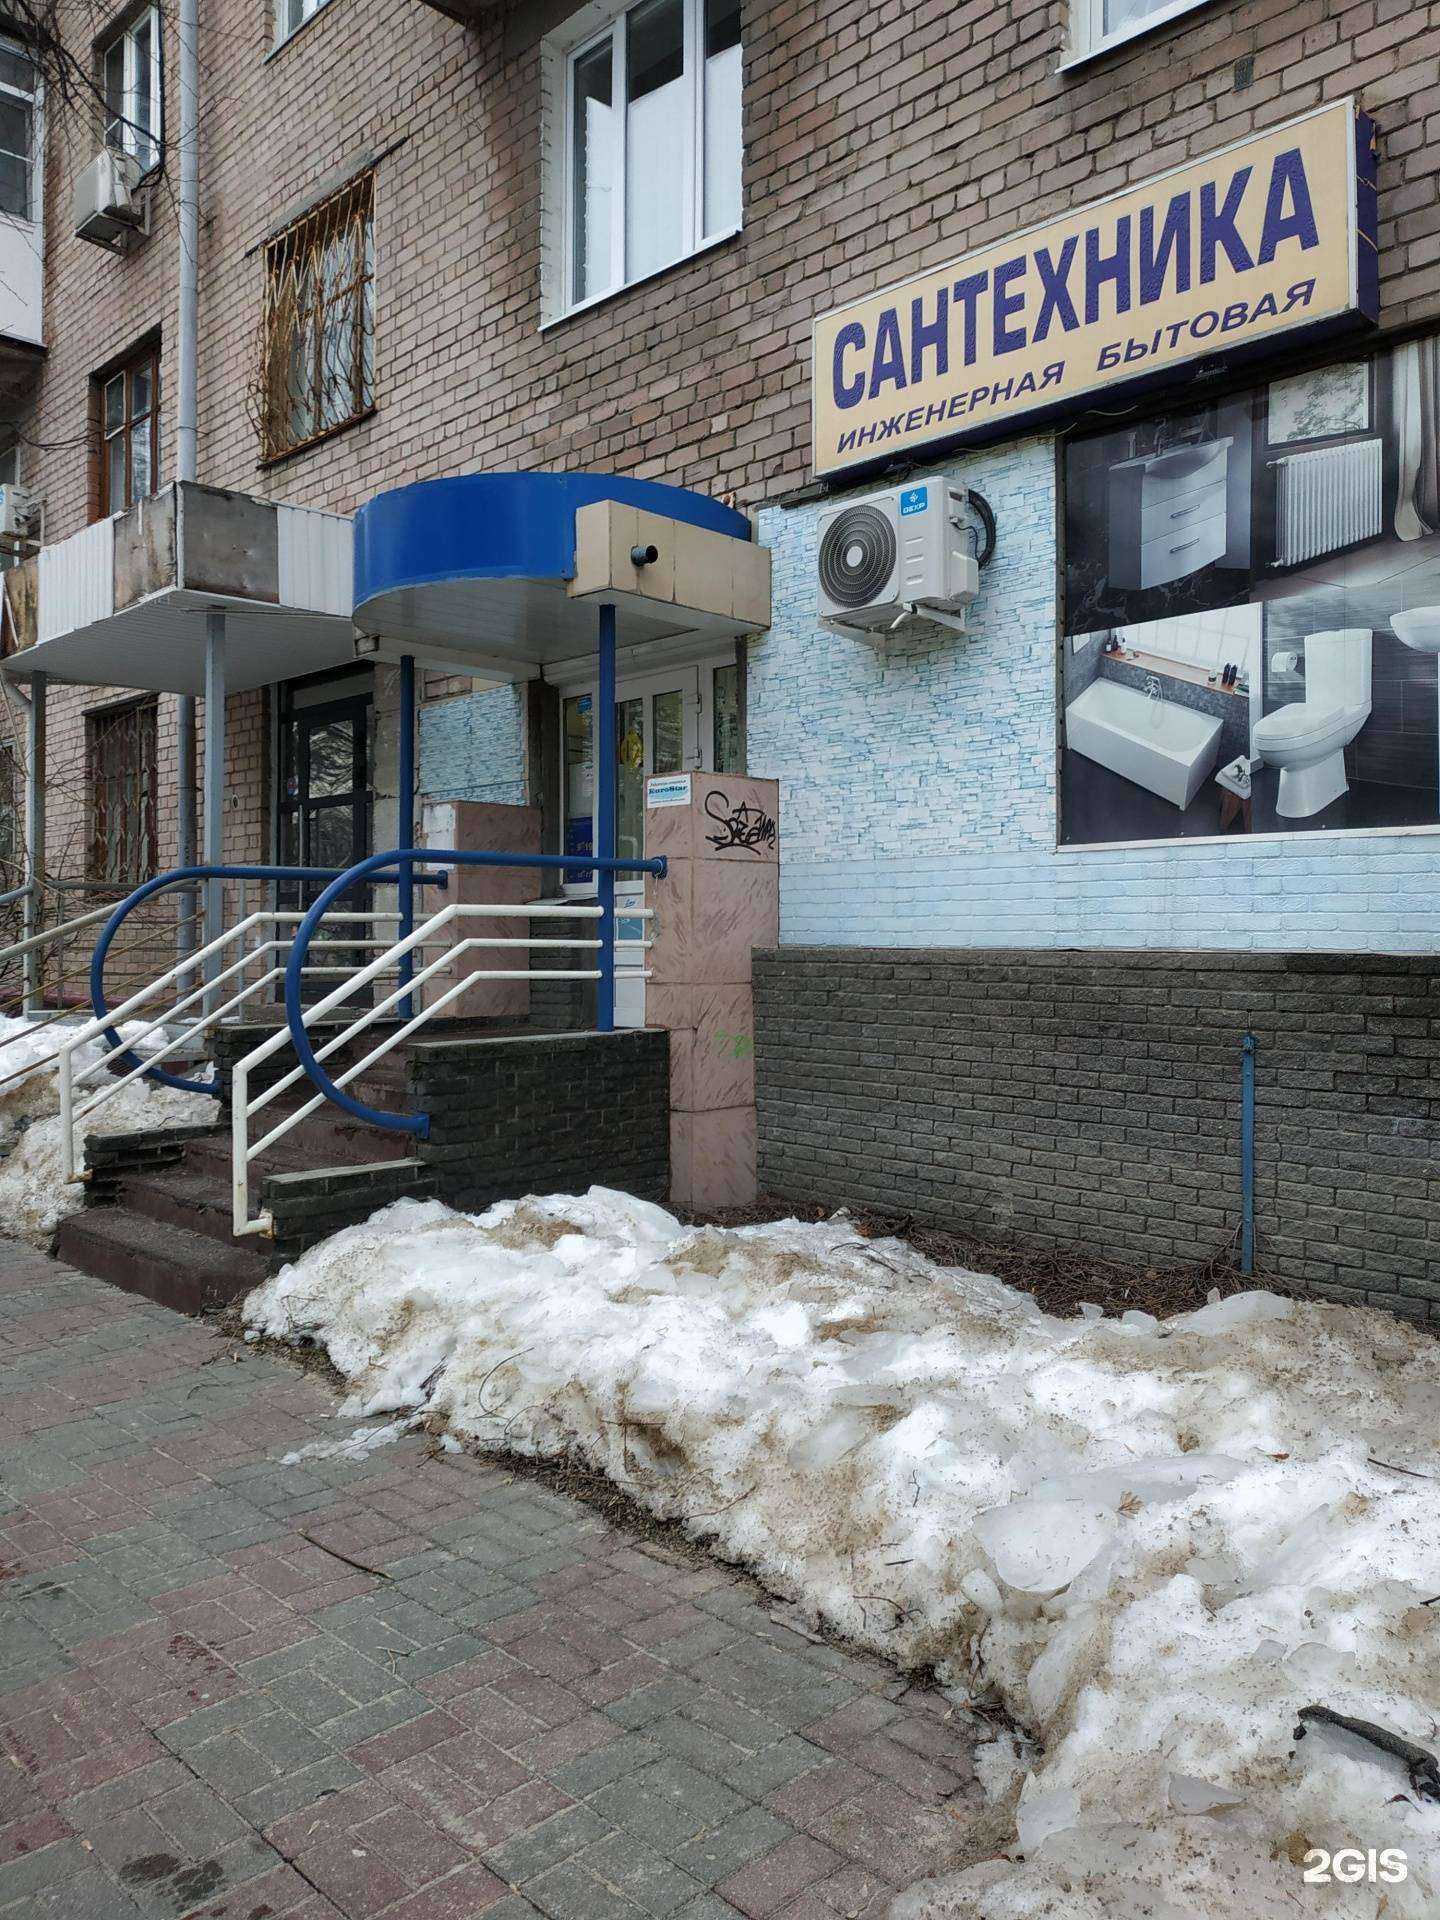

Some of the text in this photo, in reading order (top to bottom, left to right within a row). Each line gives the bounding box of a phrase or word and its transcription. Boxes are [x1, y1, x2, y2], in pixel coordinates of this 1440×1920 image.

[832, 148, 1320, 409] САНТЕХНИКА
[837, 278, 1317, 454] ИНЖЕНЕРНАЯ БЫТОВАЯ
